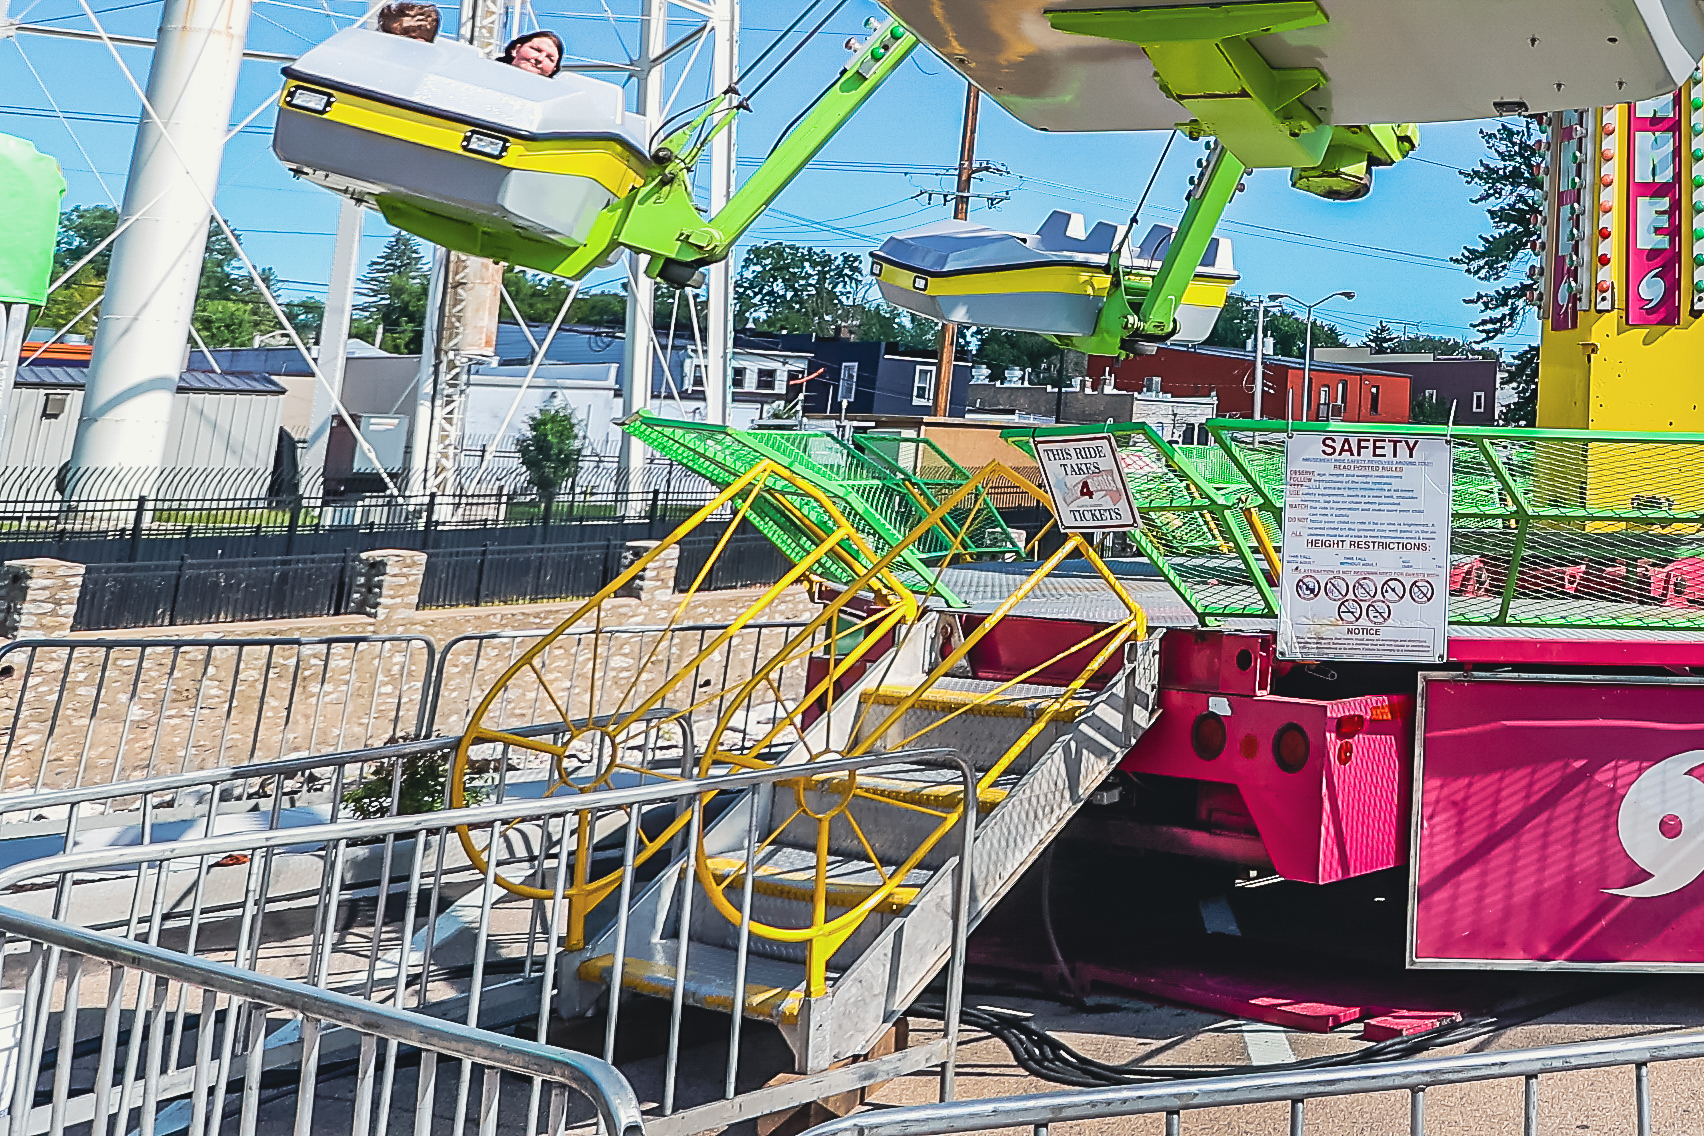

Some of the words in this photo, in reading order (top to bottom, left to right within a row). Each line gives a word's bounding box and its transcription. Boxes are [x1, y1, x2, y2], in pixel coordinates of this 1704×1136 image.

[1043, 447, 1073, 462] THIS
[1073, 445, 1106, 460] RIDE
[1321, 436, 1420, 459] SAFETY
[1060, 461, 1101, 476] TAKES
[1289, 469, 1316, 477] OBSERVE
[1080, 480, 1094, 499] 4
[1069, 507, 1122, 522] TICKETS
[1306, 539, 1347, 549] HEIGHT
[1349, 540, 1431, 552] RESTRICTIONS:
[1346, 627, 1381, 636] NOTICE
